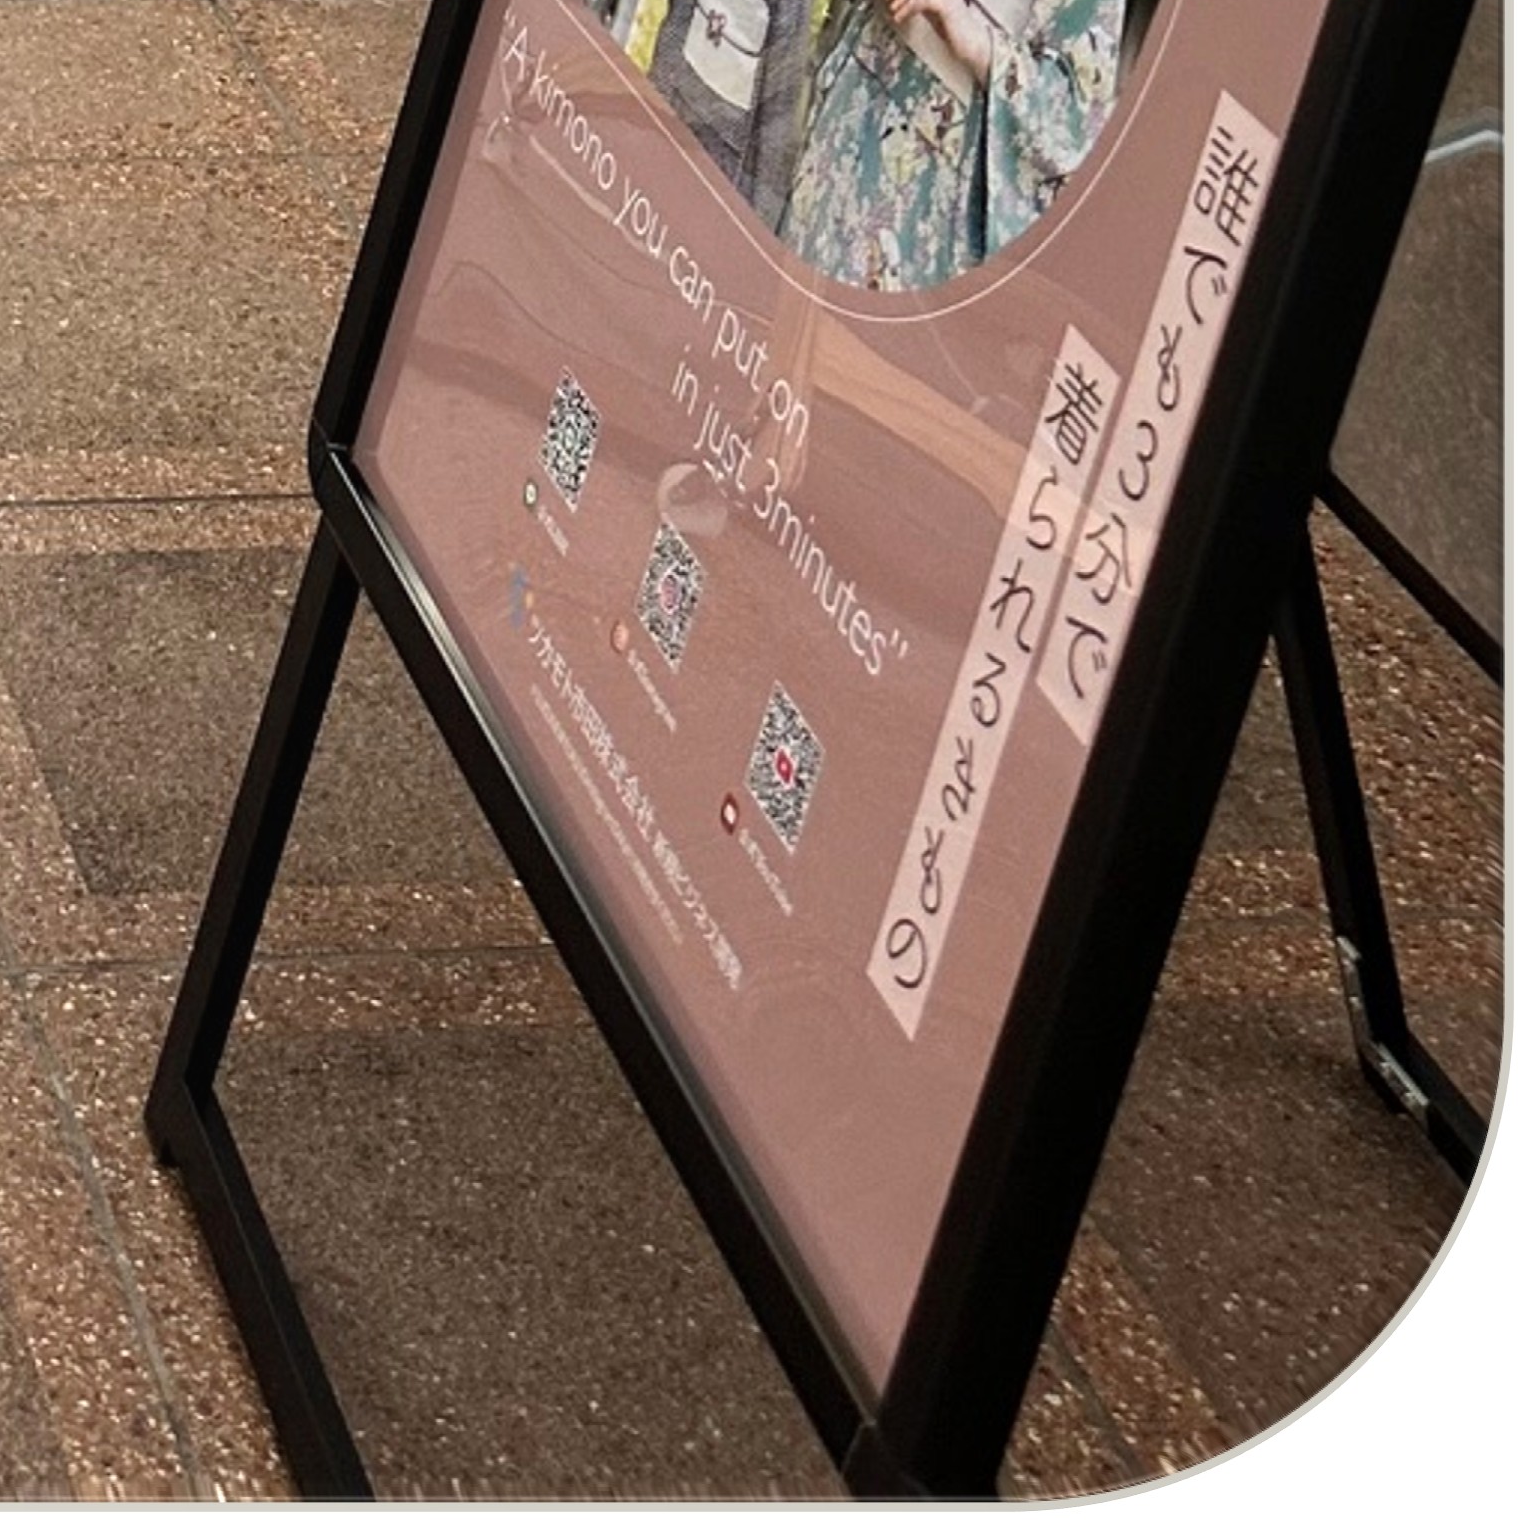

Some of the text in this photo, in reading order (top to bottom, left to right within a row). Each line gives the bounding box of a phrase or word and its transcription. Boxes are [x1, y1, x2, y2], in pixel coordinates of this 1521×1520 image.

[529, 49, 618, 189] kimono
[611, 176, 668, 254] you
[668, 245, 716, 322] can
[712, 308, 769, 392] put
[769, 379, 809, 448] on
[671, 344, 698, 416] in
[693, 385, 752, 492] just
[884, 360, 1106, 991] 着られるきもの
